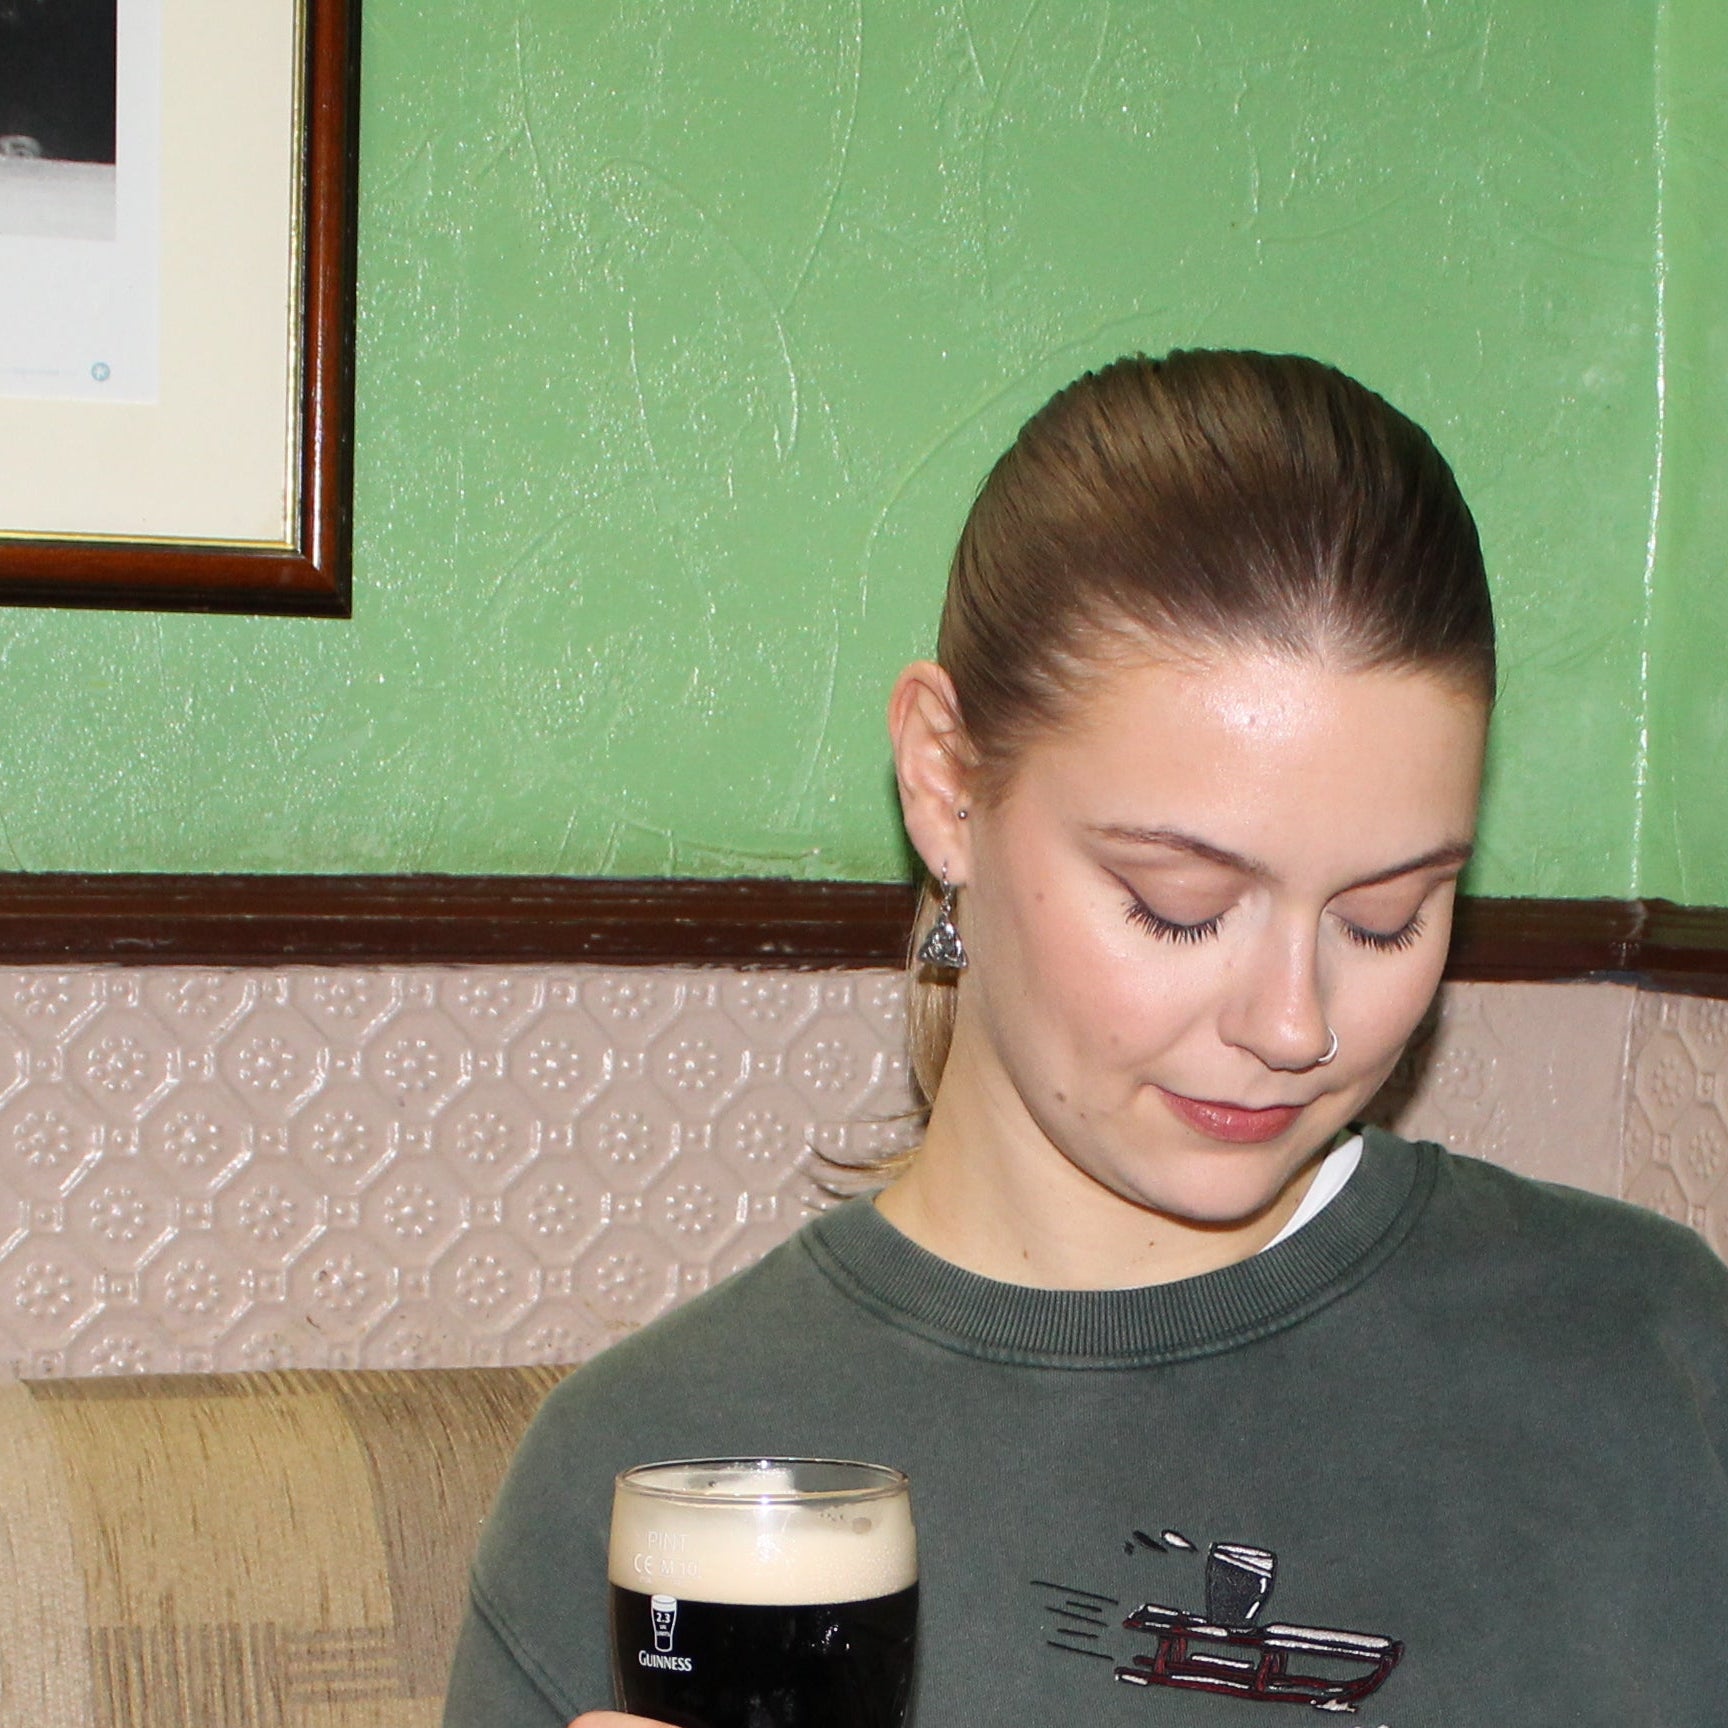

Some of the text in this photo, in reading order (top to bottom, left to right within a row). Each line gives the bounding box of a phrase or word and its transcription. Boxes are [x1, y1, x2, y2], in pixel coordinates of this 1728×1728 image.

[648, 1530, 688, 1552] PINT
[656, 1612, 671, 1624] 2.3
[638, 1649, 693, 1672] GUINNESS
